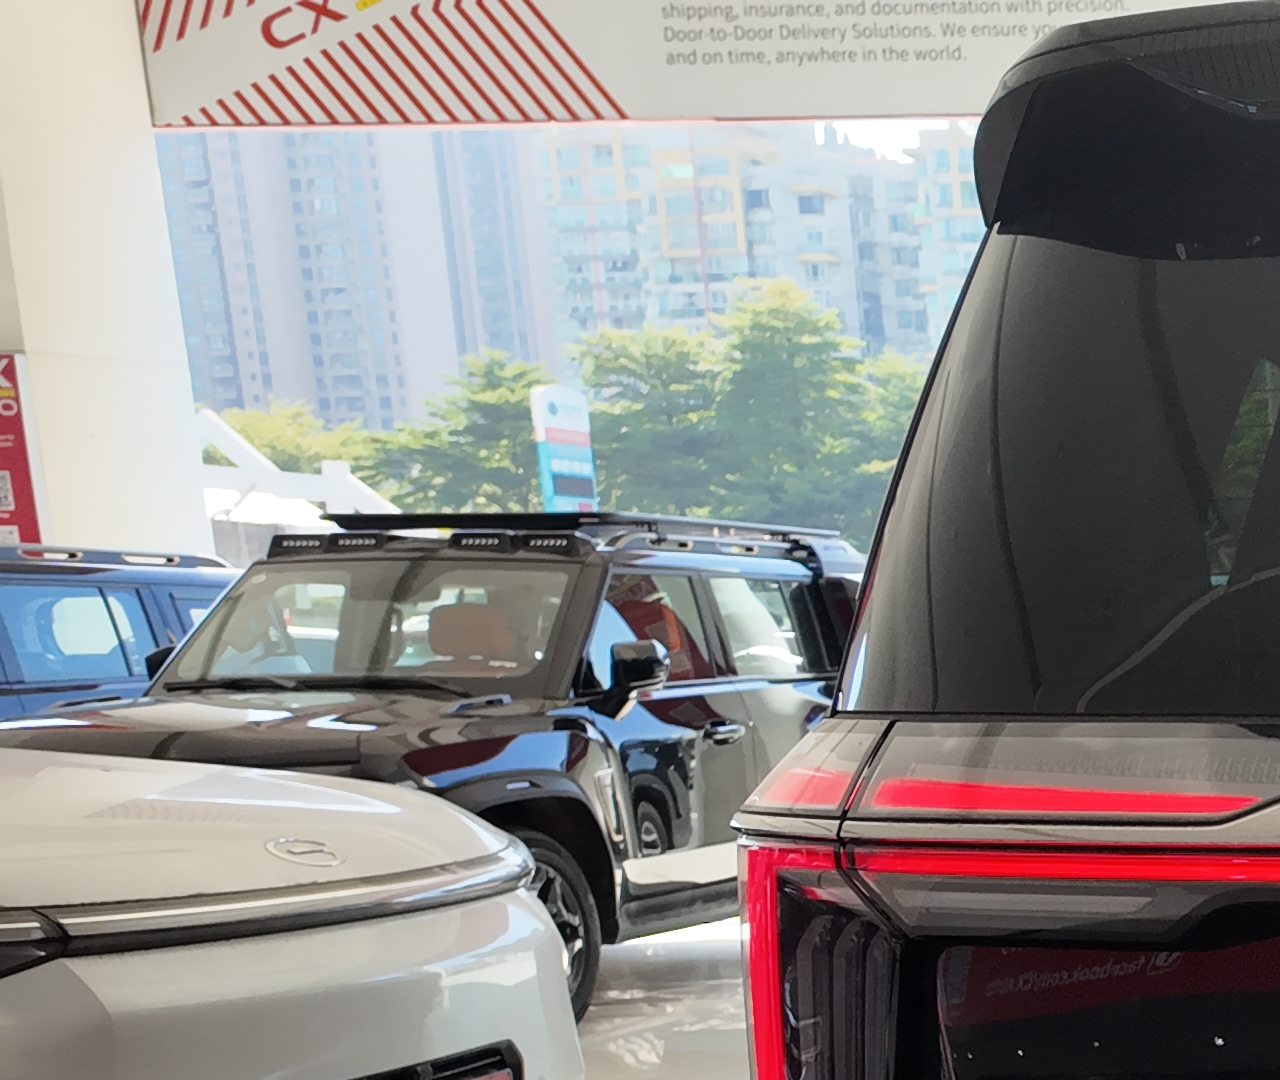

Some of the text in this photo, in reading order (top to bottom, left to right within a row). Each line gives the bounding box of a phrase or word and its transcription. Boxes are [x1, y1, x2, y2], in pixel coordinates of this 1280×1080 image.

[661, 0, 1130, 23] shipping, insurance, and documentation with precision.
[663, 22, 1056, 44] Door-to-Door Delivery Solutions. We ensure yo
[665, 45, 968, 68] and on time, anywhere in the world.
